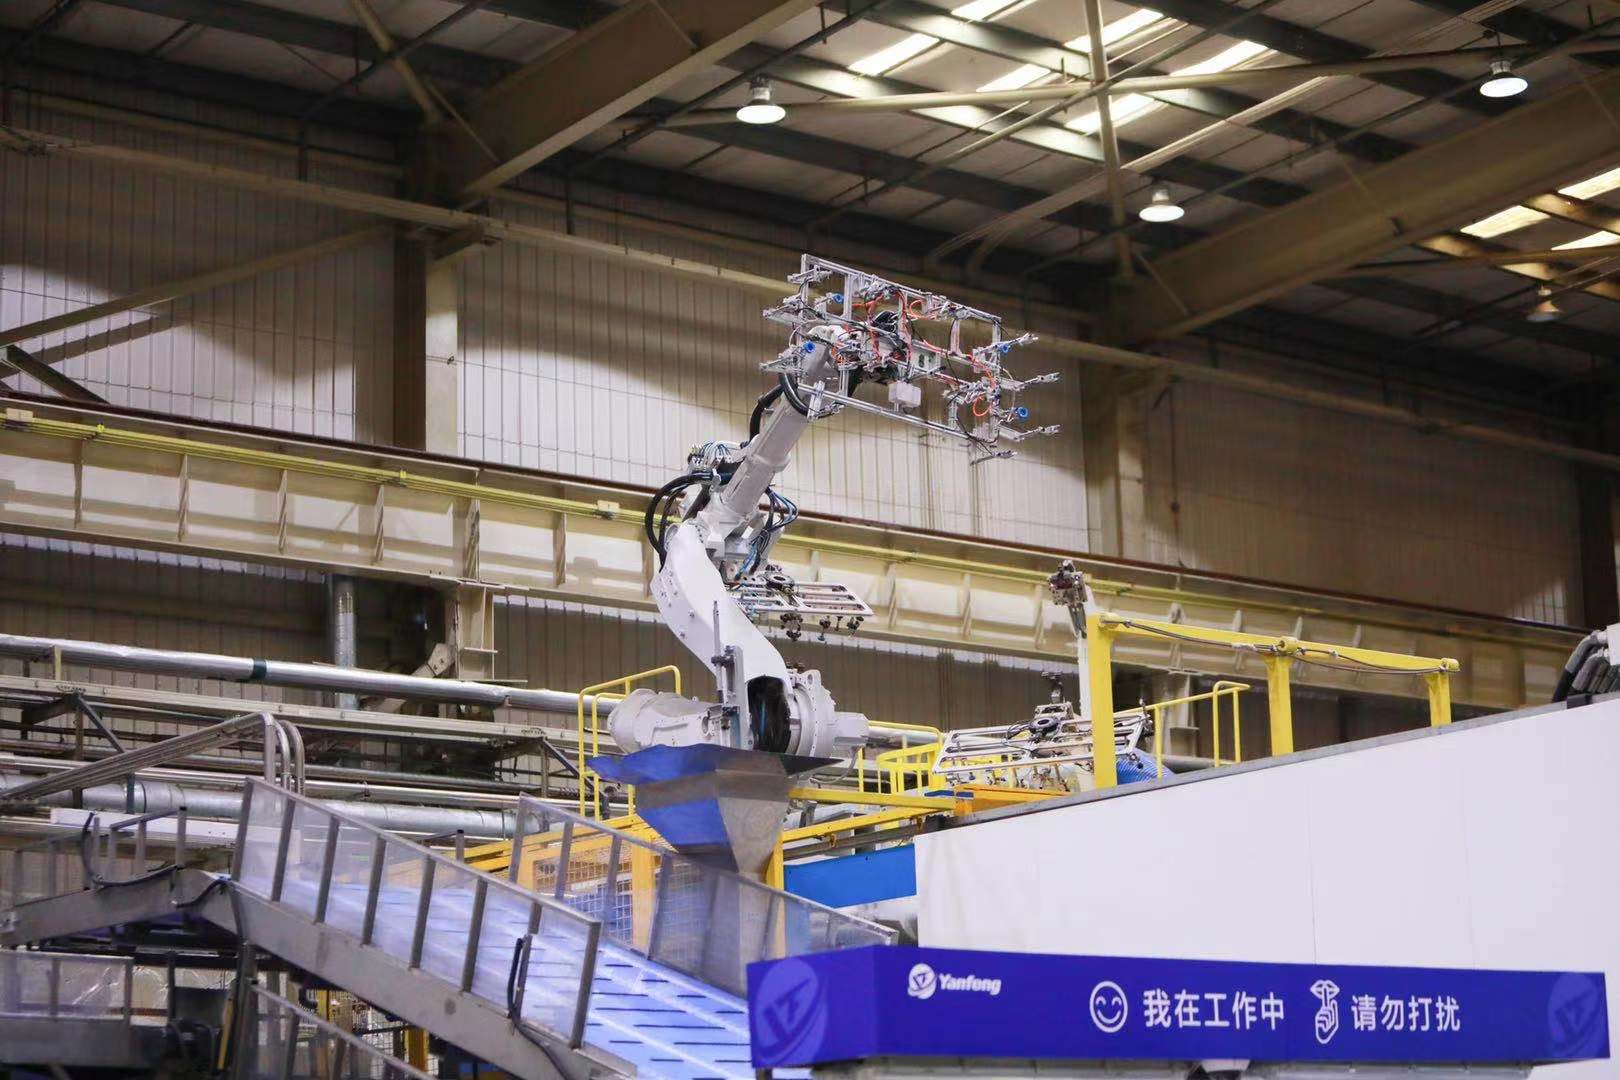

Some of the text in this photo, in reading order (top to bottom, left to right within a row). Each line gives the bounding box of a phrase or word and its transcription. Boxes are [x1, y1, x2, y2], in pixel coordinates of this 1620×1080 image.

[1143, 989, 1461, 1032] 我在工作中 请勿打扰
